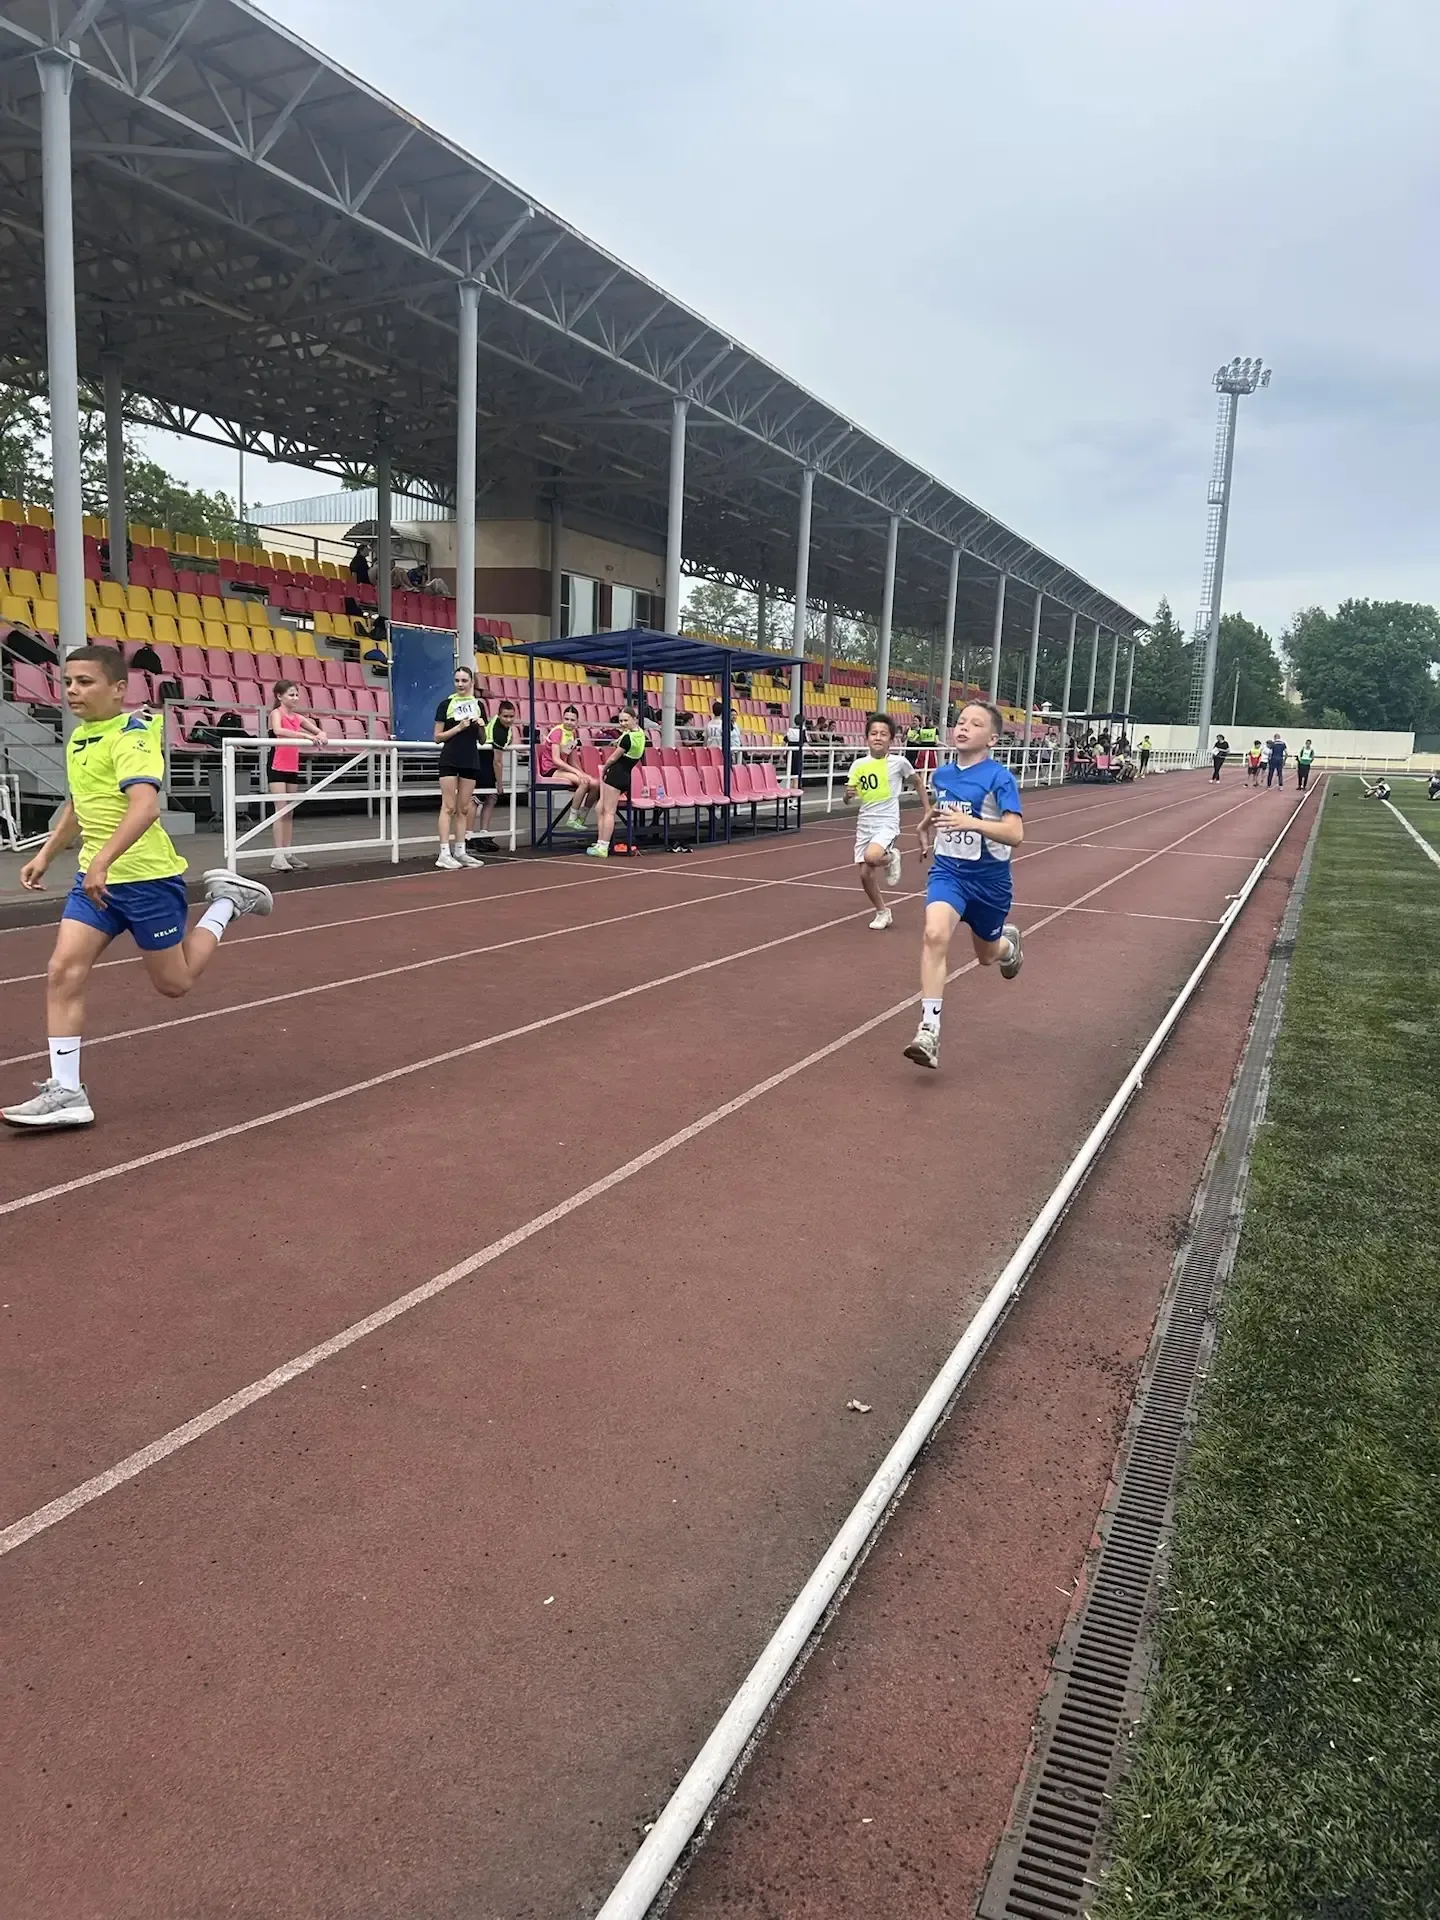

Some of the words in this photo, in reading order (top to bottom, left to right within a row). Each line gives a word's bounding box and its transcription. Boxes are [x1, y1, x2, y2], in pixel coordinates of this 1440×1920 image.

[456, 704, 472, 715] 361
[944, 831, 974, 846] 336
[153, 926, 178, 938] KELME
